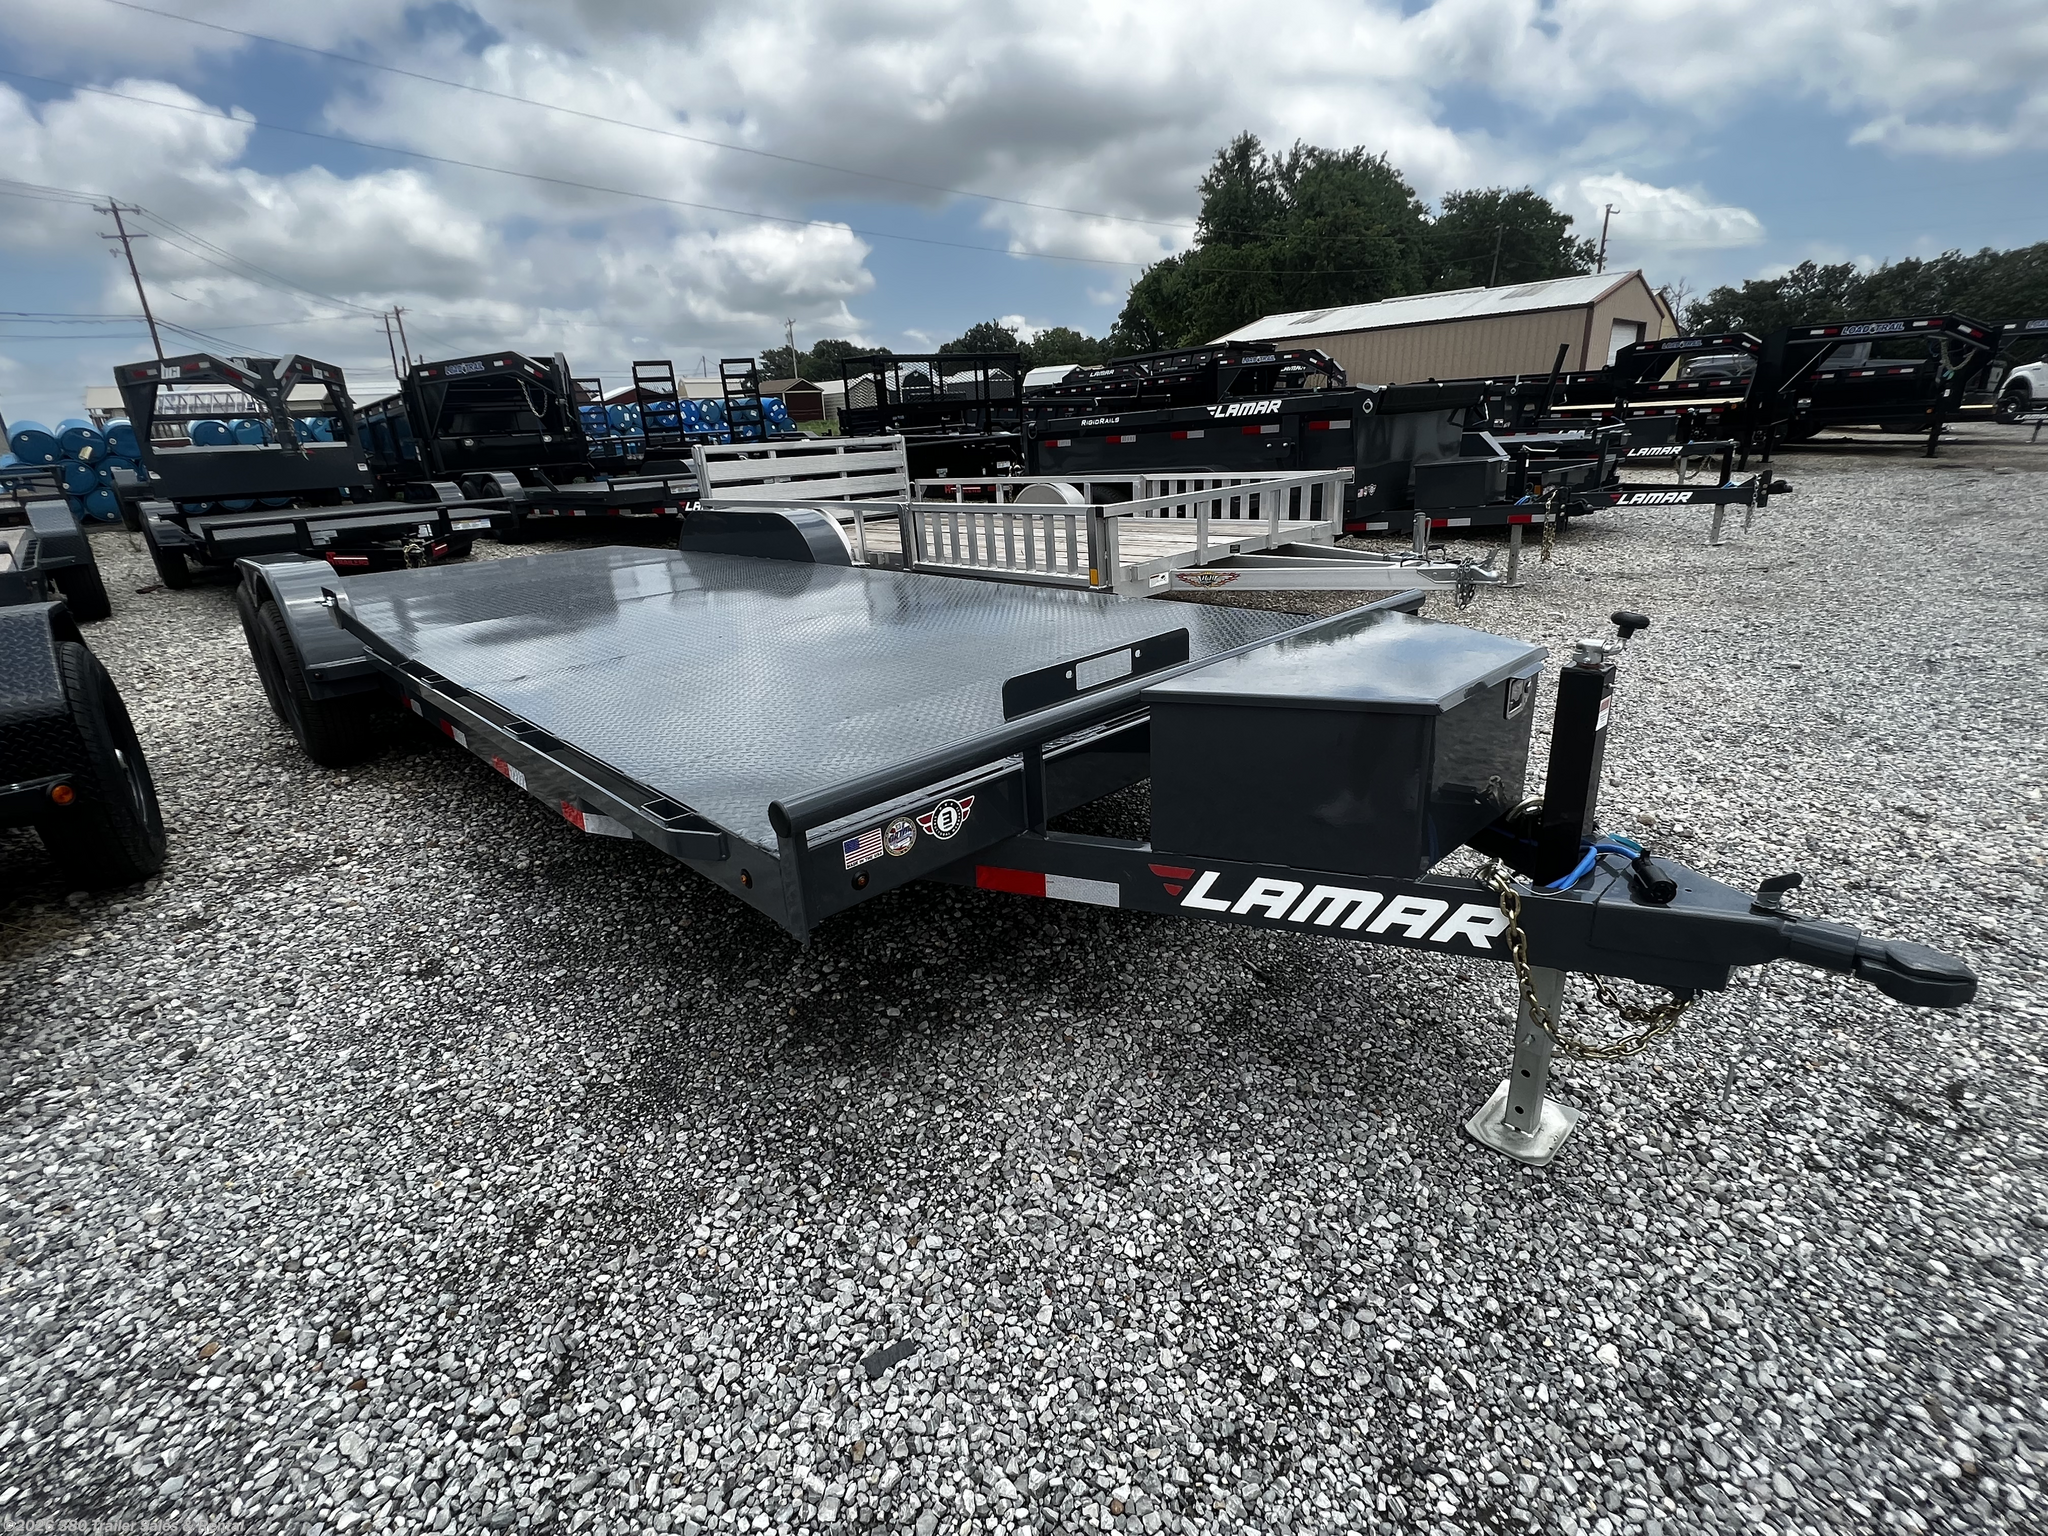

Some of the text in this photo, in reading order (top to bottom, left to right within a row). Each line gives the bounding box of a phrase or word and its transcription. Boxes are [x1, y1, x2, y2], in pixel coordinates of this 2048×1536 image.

[1841, 322, 1905, 335] LOAD TRAIL
[1214, 400, 1283, 418] LAMAR
[1627, 446, 1684, 457] LAMAR
[1616, 491, 1694, 505] LAMAR
[1180, 870, 1510, 949] LAMAR
